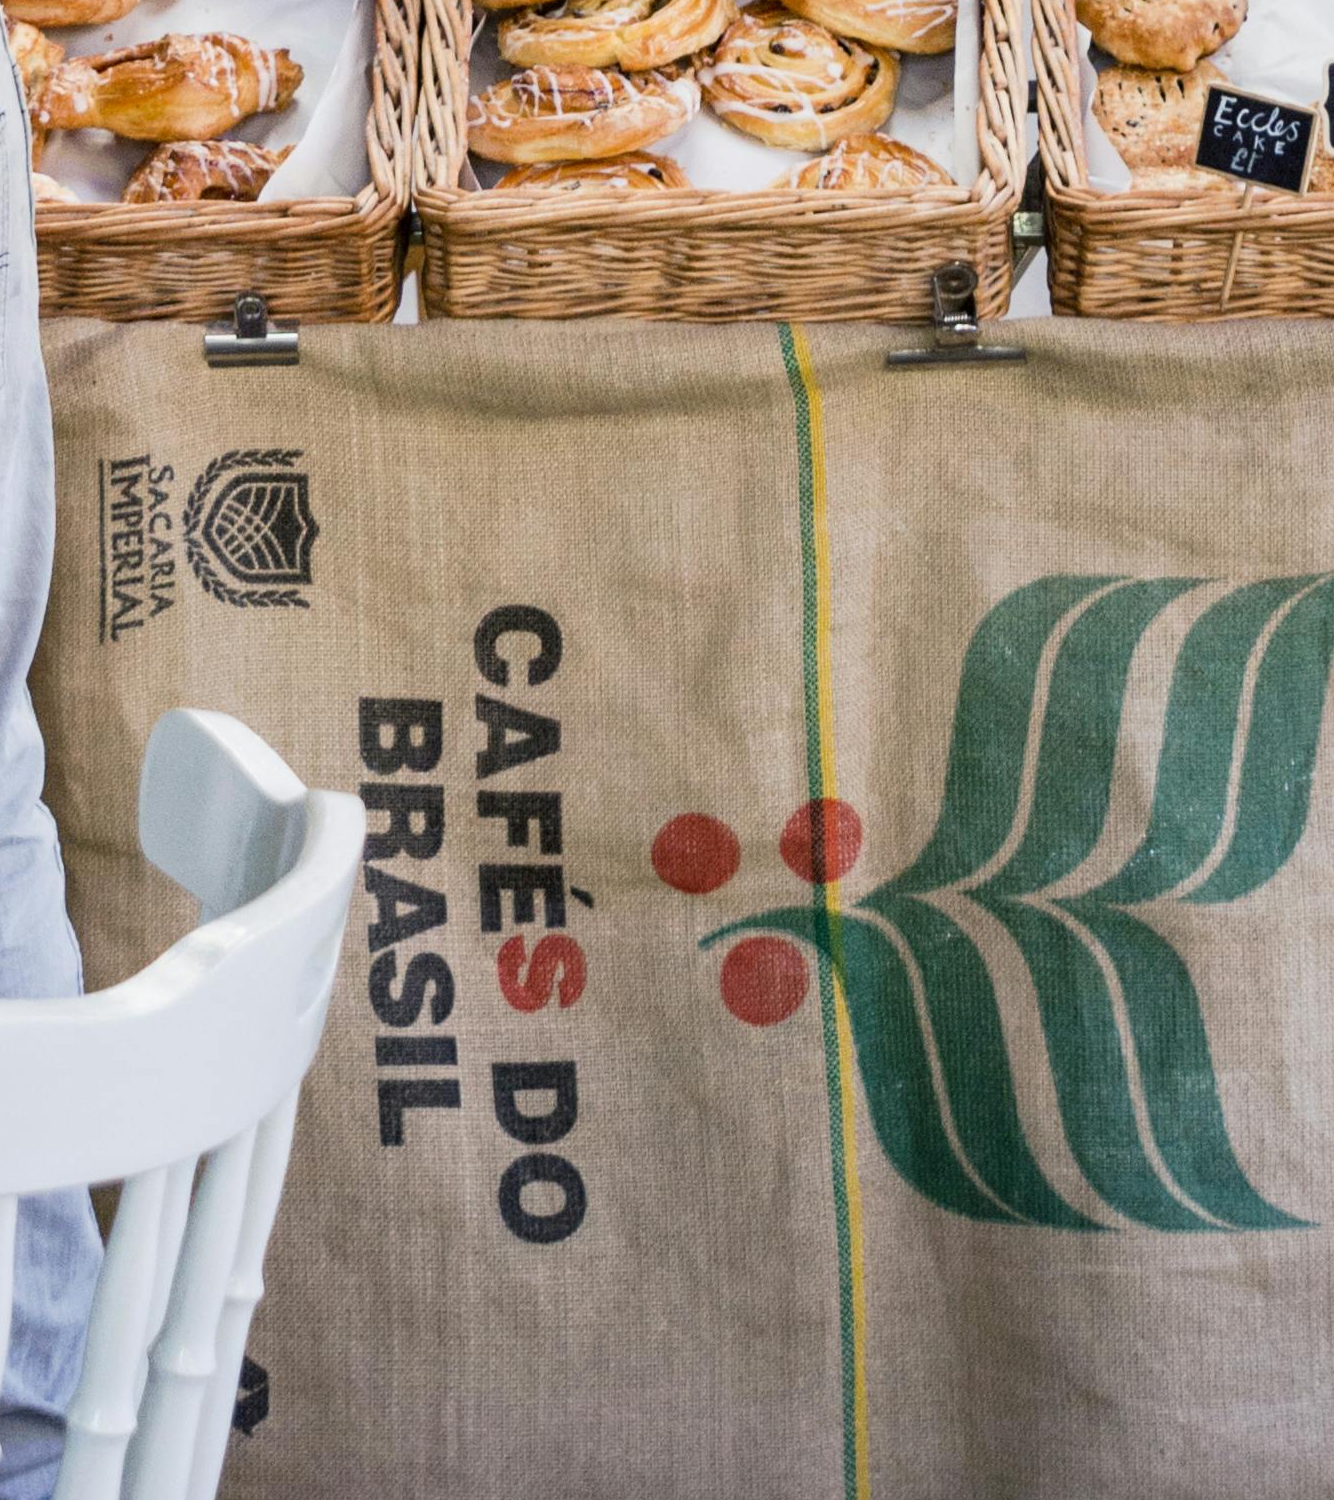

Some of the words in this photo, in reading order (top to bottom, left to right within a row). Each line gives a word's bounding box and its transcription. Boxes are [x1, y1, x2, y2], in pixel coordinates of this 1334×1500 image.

[1213, 95, 1302, 142] Eccles
[1213, 124, 1286, 156] CAKE
[110, 453, 151, 642] IMPERIAL
[146, 464, 176, 618] SACARIA
[473, 604, 594, 1014] CAFÉS
[357, 695, 462, 1147] BRASIL
[491, 1060, 587, 1245] DO
